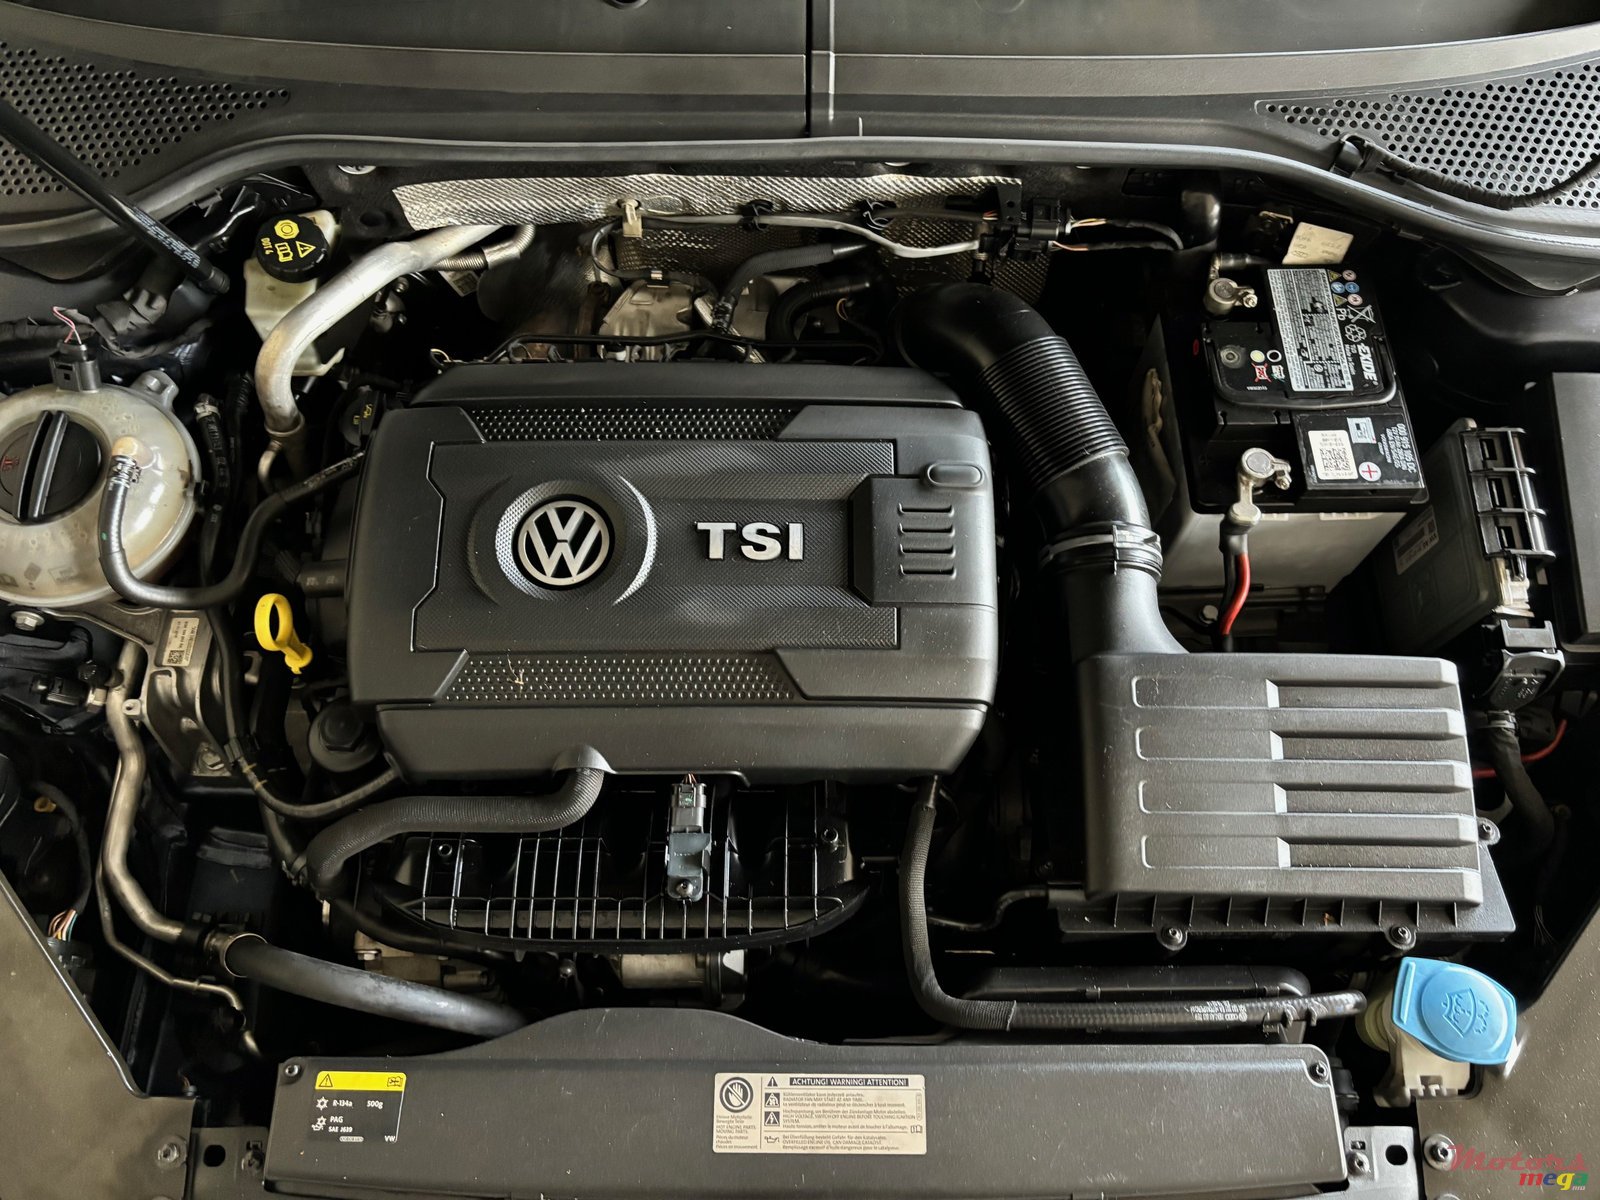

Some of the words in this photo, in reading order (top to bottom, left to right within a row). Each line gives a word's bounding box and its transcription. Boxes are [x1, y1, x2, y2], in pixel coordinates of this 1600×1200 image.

[1336, 308, 1348, 320] Pb
[1357, 342, 1378, 381] EXIDE
[1400, 436, 1411, 449] 915
[696, 521, 804, 561] TSI
[366, 1100, 384, 1110] 500g
